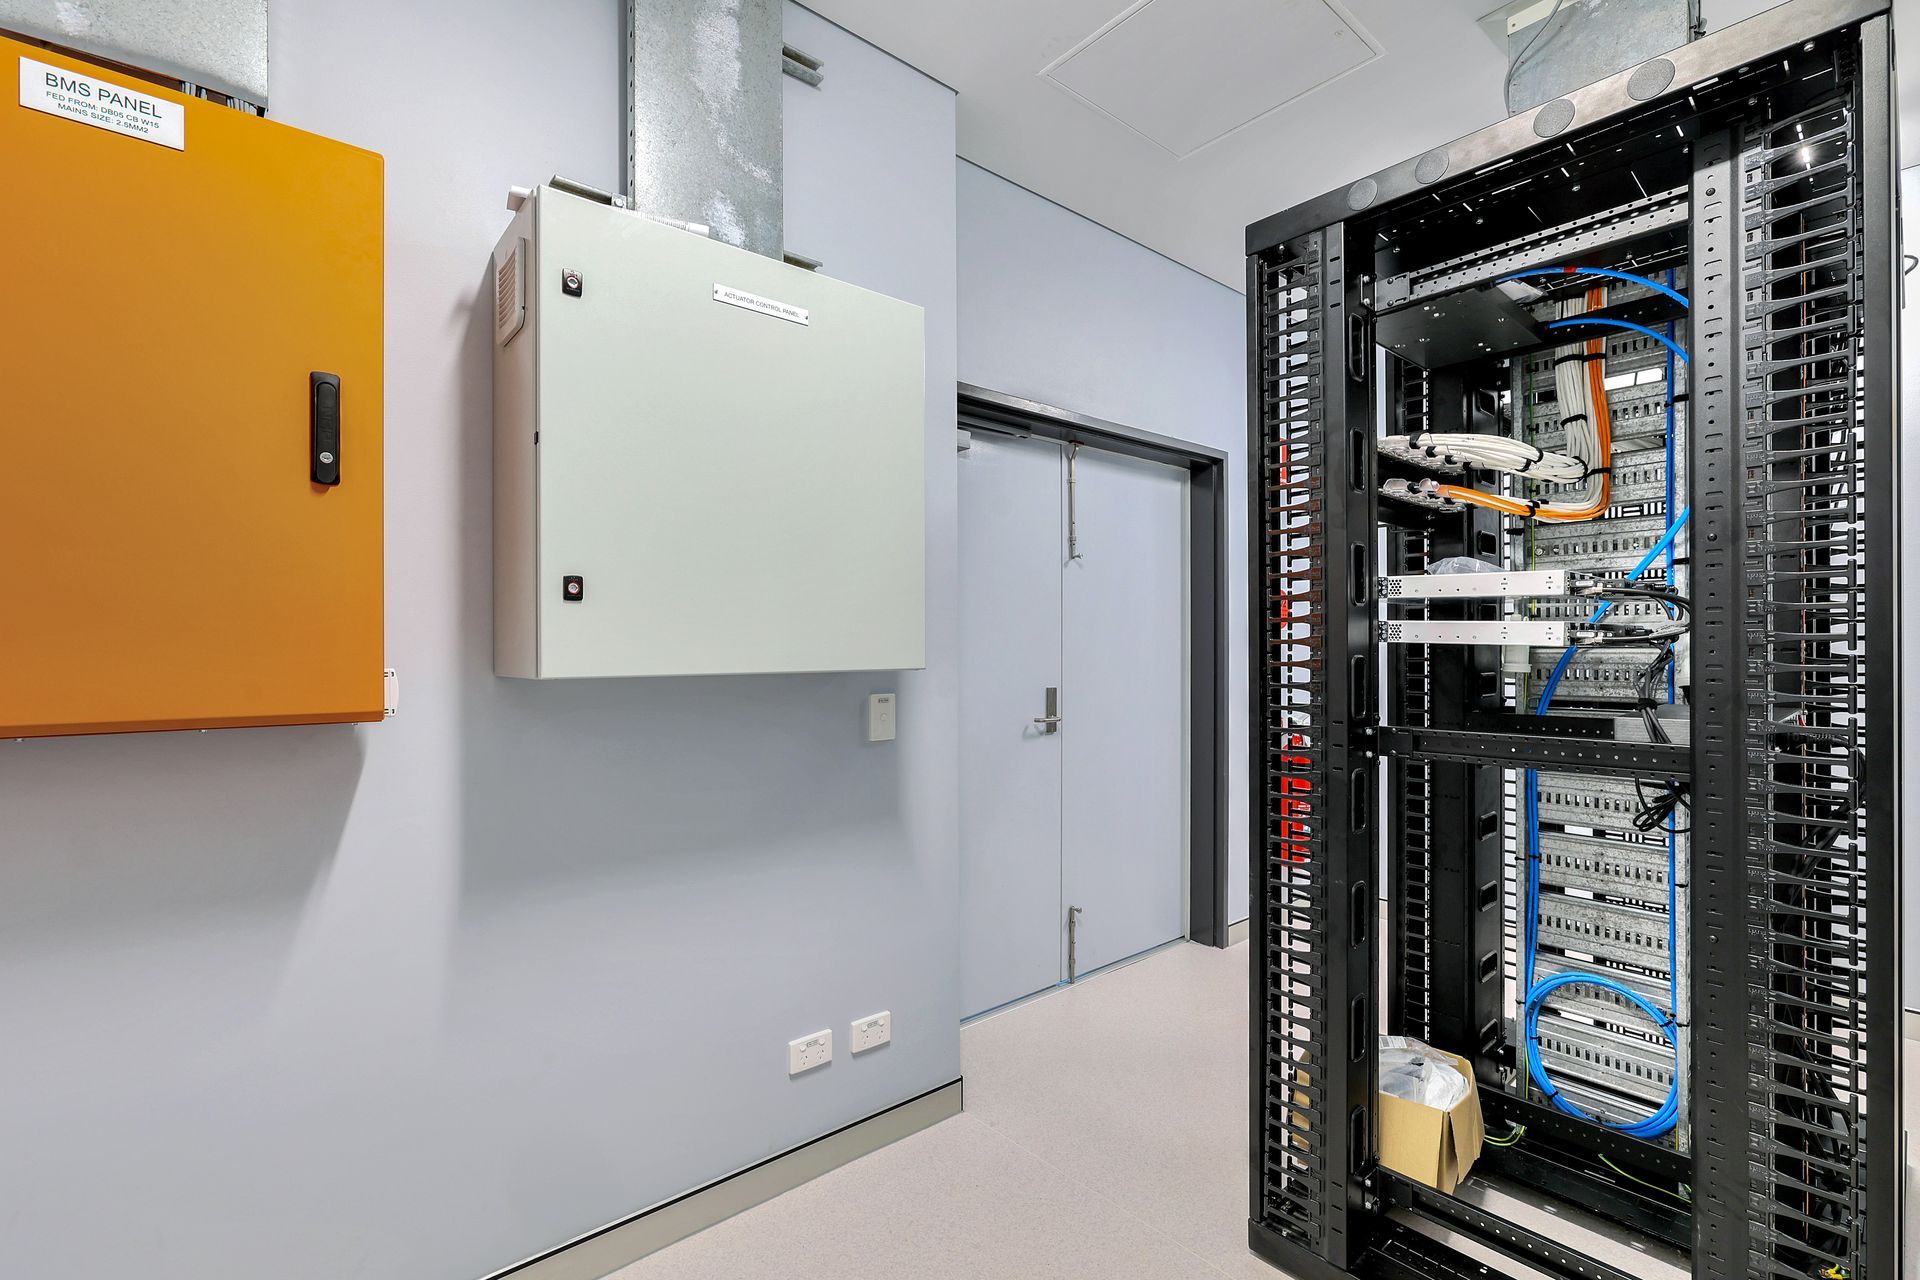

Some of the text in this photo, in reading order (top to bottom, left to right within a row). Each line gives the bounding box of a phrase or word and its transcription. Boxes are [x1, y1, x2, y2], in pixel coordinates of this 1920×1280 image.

[45, 72, 163, 119] BMS PANEL
[46, 91, 160, 129] FED FROM: DB05 CB W15
[57, 102, 149, 134] MAINS SIZE: 2.5MM2
[724, 291, 800, 318] ACTUATOR CONTROL PANEL
